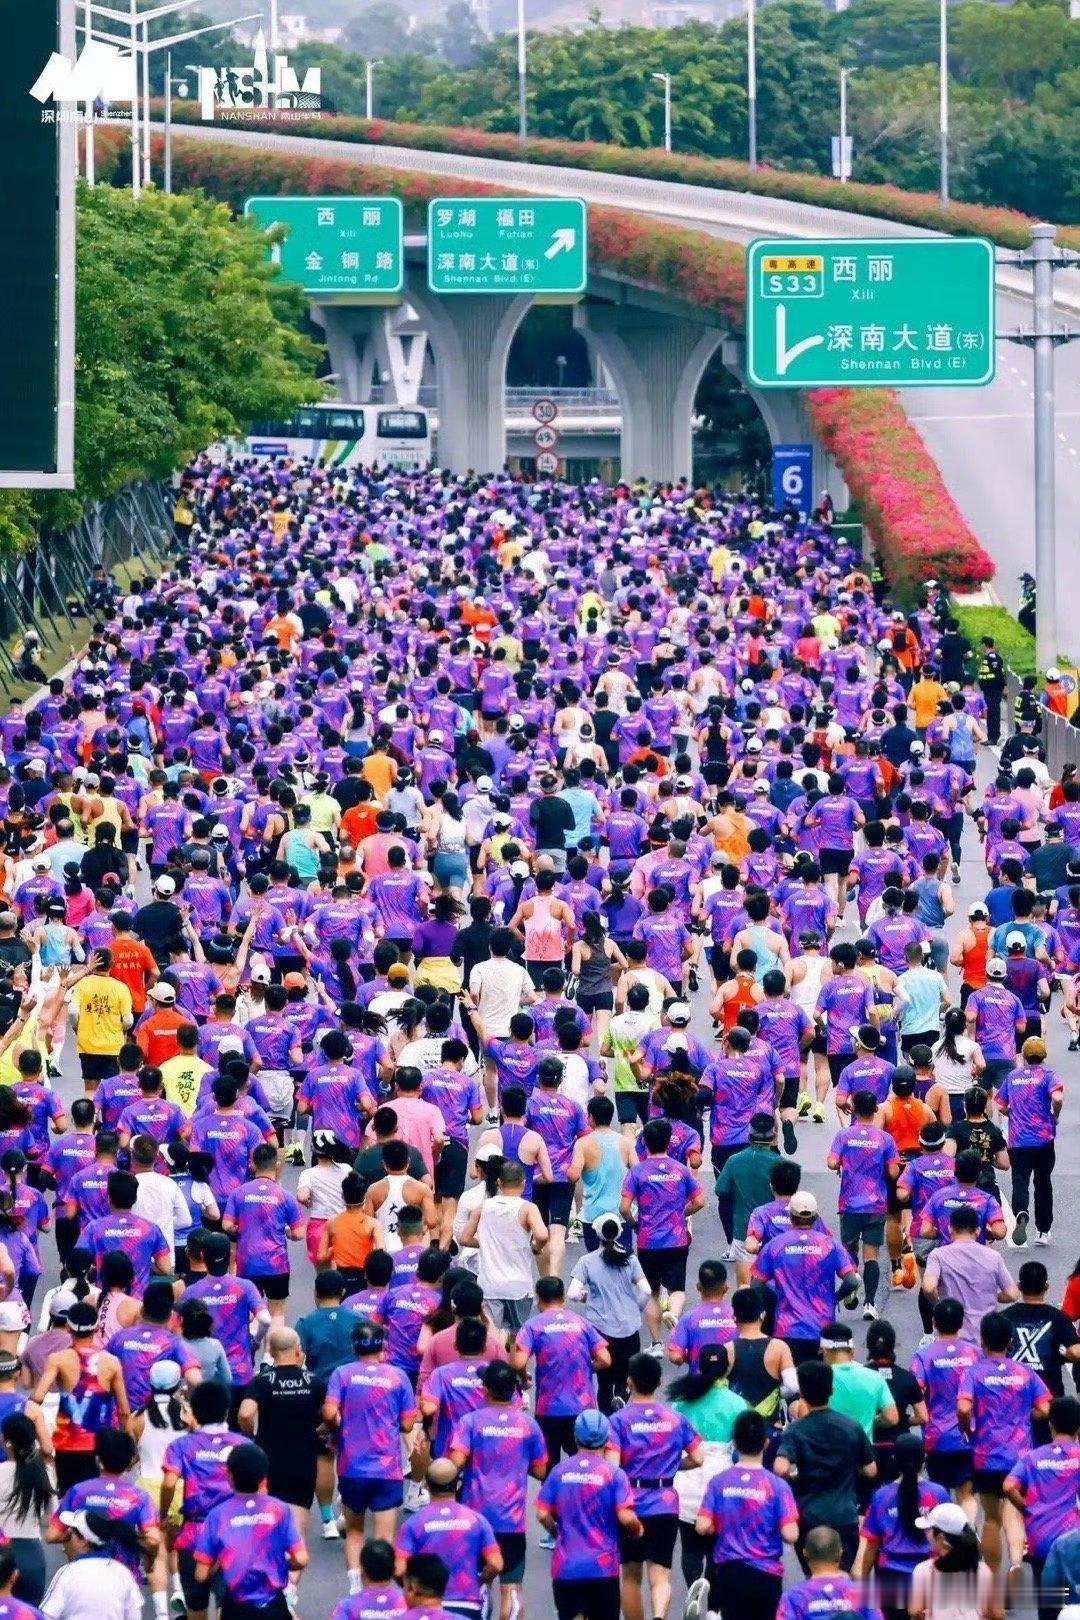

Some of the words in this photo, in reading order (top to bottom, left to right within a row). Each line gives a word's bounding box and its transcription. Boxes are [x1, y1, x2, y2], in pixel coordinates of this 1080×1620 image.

[316, 207, 382, 226] 西丽
[437, 208, 477, 227] 罗湖
[496, 208, 535, 227] 福田
[339, 229, 356, 238] Xili
[440, 229, 474, 239] Luohu
[499, 229, 533, 239] Futian
[831, 254, 894, 282] 西丽
[364, 274, 379, 283] Rd
[443, 275, 488, 284] Shennan
[493, 275, 517, 284] Blvd
[769, 275, 817, 293] S33
[851, 288, 875, 300] Xili
[840, 357, 901, 370] Shennan
[911, 357, 942, 370] Blvd
[947, 356, 967, 369] (E)
[782, 465, 804, 495] 6
[278, 1379, 304, 1388] YOU
